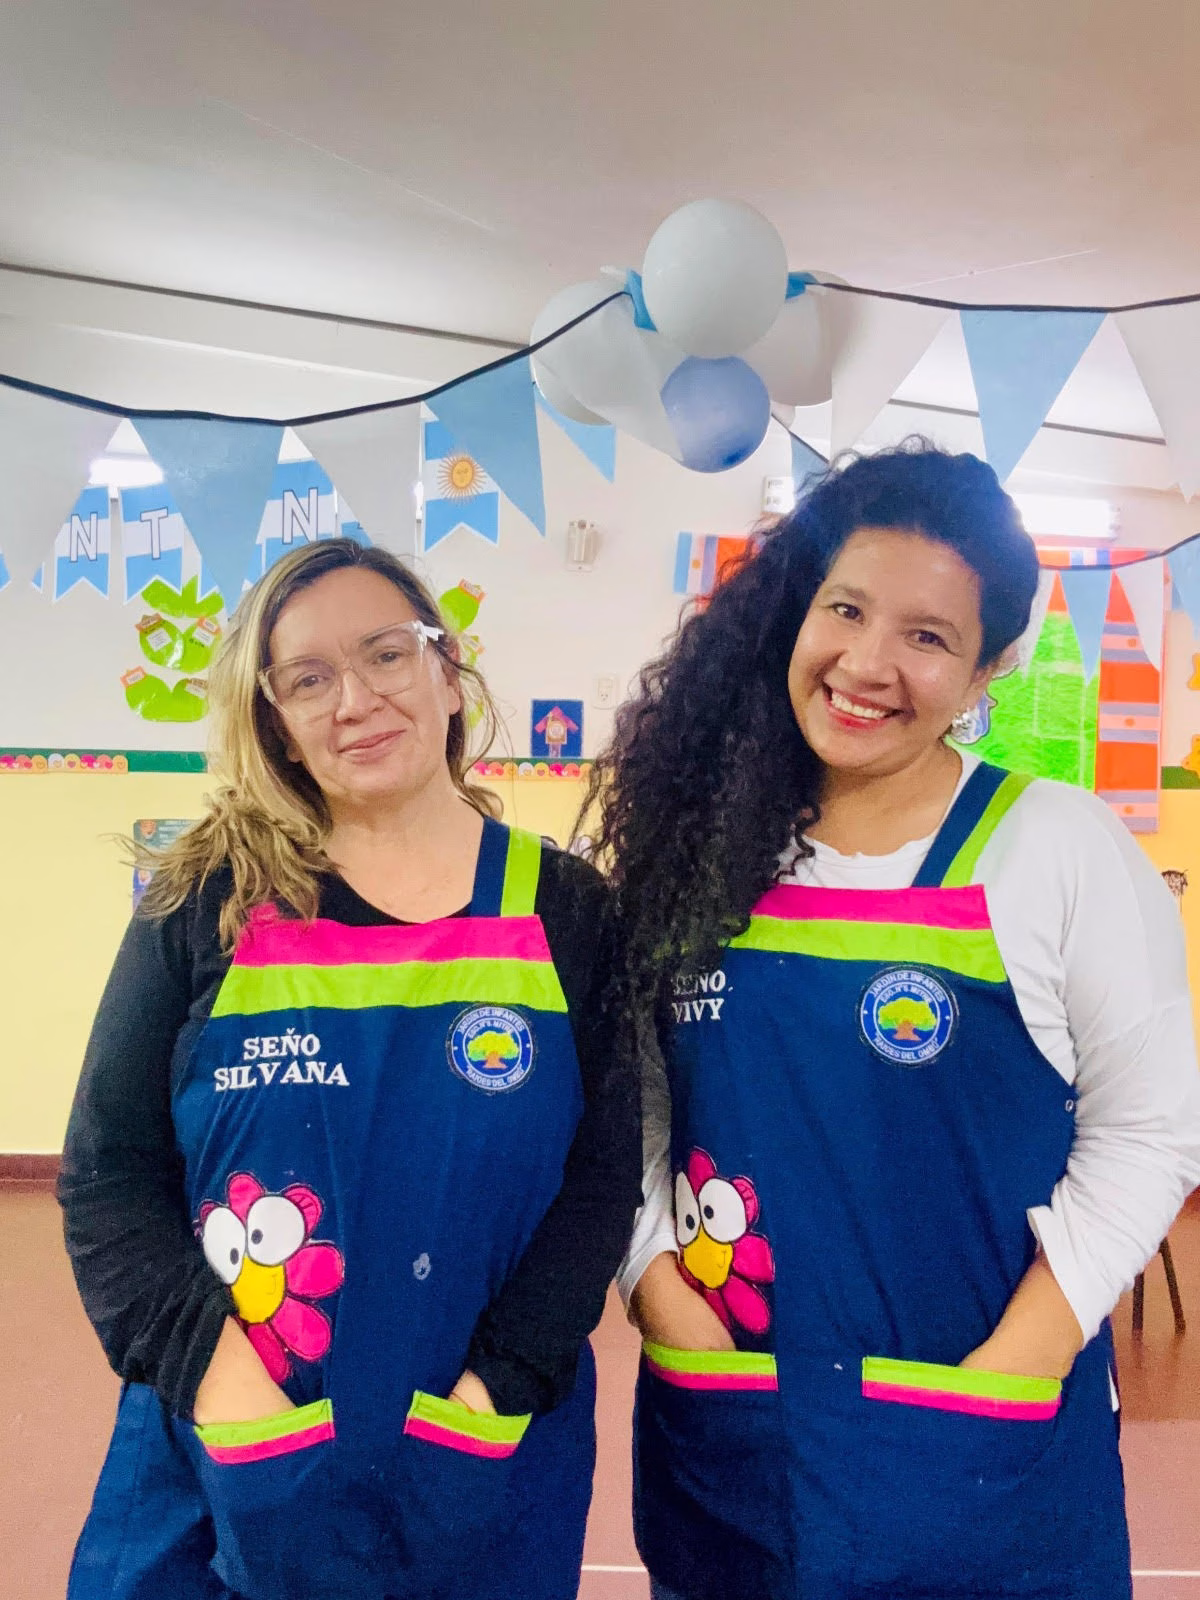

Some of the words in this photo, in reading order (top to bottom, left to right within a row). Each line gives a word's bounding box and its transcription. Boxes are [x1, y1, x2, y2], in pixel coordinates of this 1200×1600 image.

[671, 998, 725, 1024] VIVY
[243, 1027, 321, 1061] SEÑO
[900, 1050, 918, 1059] DEL
[213, 1060, 350, 1091] SILVANA
